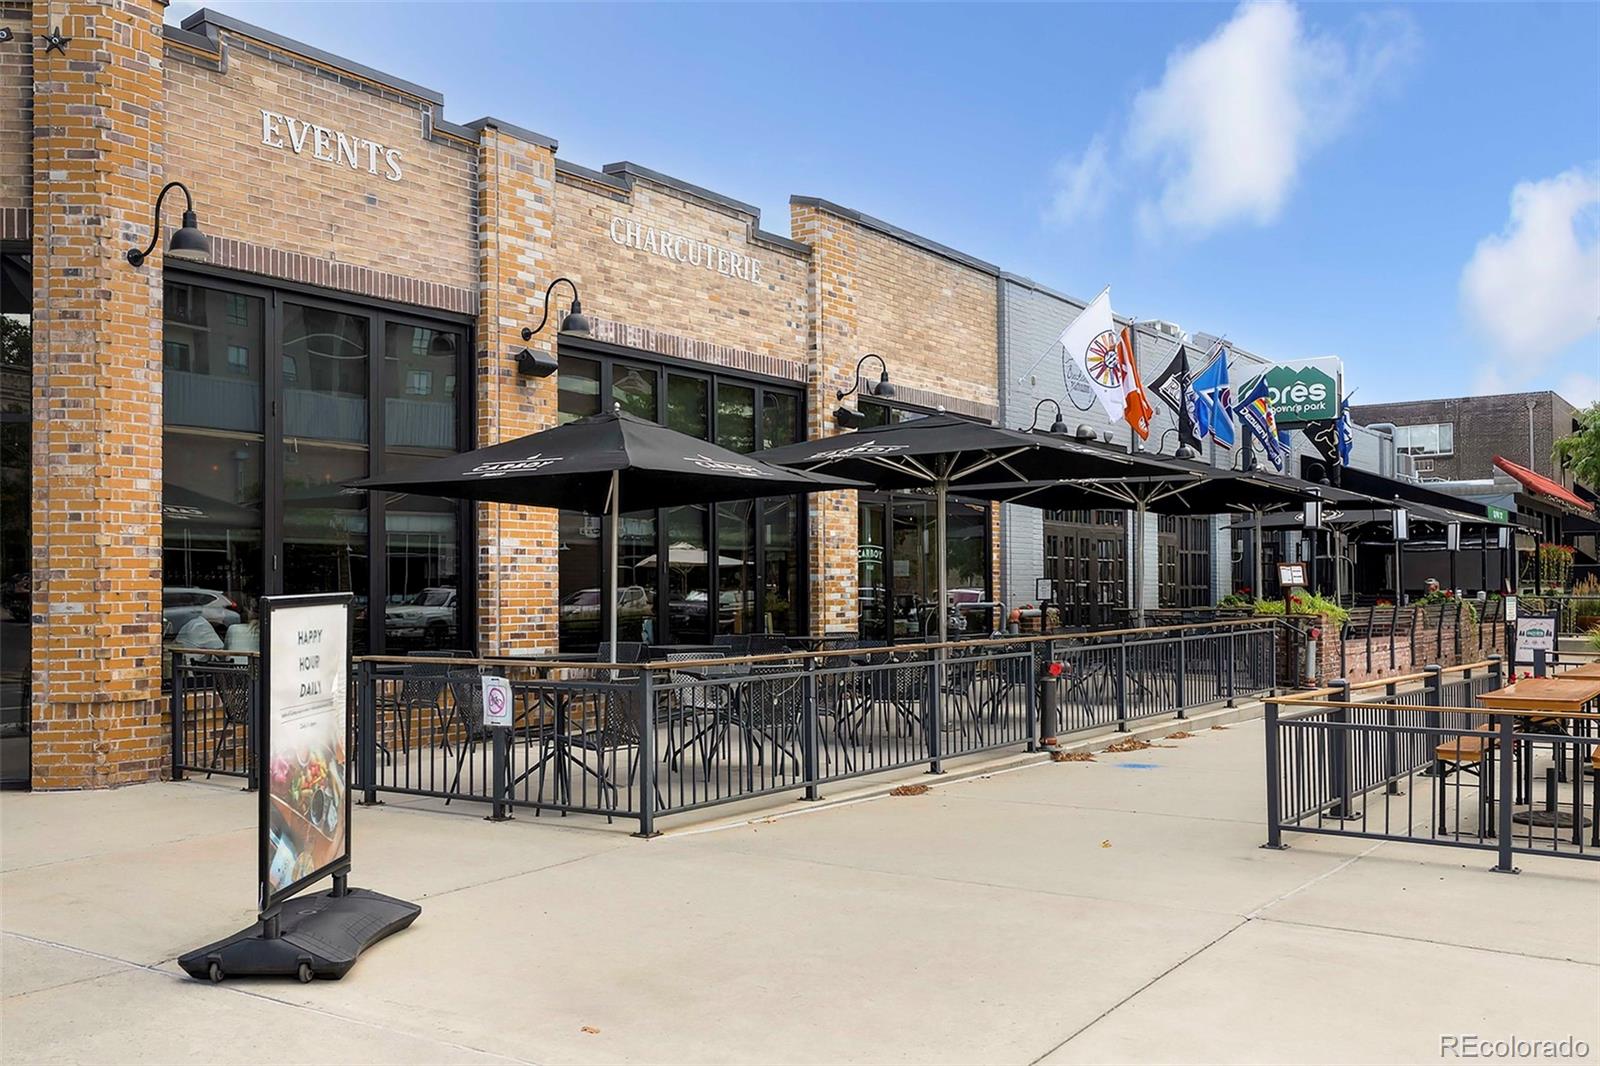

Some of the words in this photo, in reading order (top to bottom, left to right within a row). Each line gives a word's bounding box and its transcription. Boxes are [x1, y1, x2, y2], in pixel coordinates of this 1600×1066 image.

[260, 109, 403, 182] EVENTS
[610, 216, 763, 284] CHARCUTERIE
[1303, 401, 1327, 413] park
[297, 629, 323, 645] HAPPY
[298, 655, 320, 671] HOUR
[299, 680, 322, 698] DAILY
